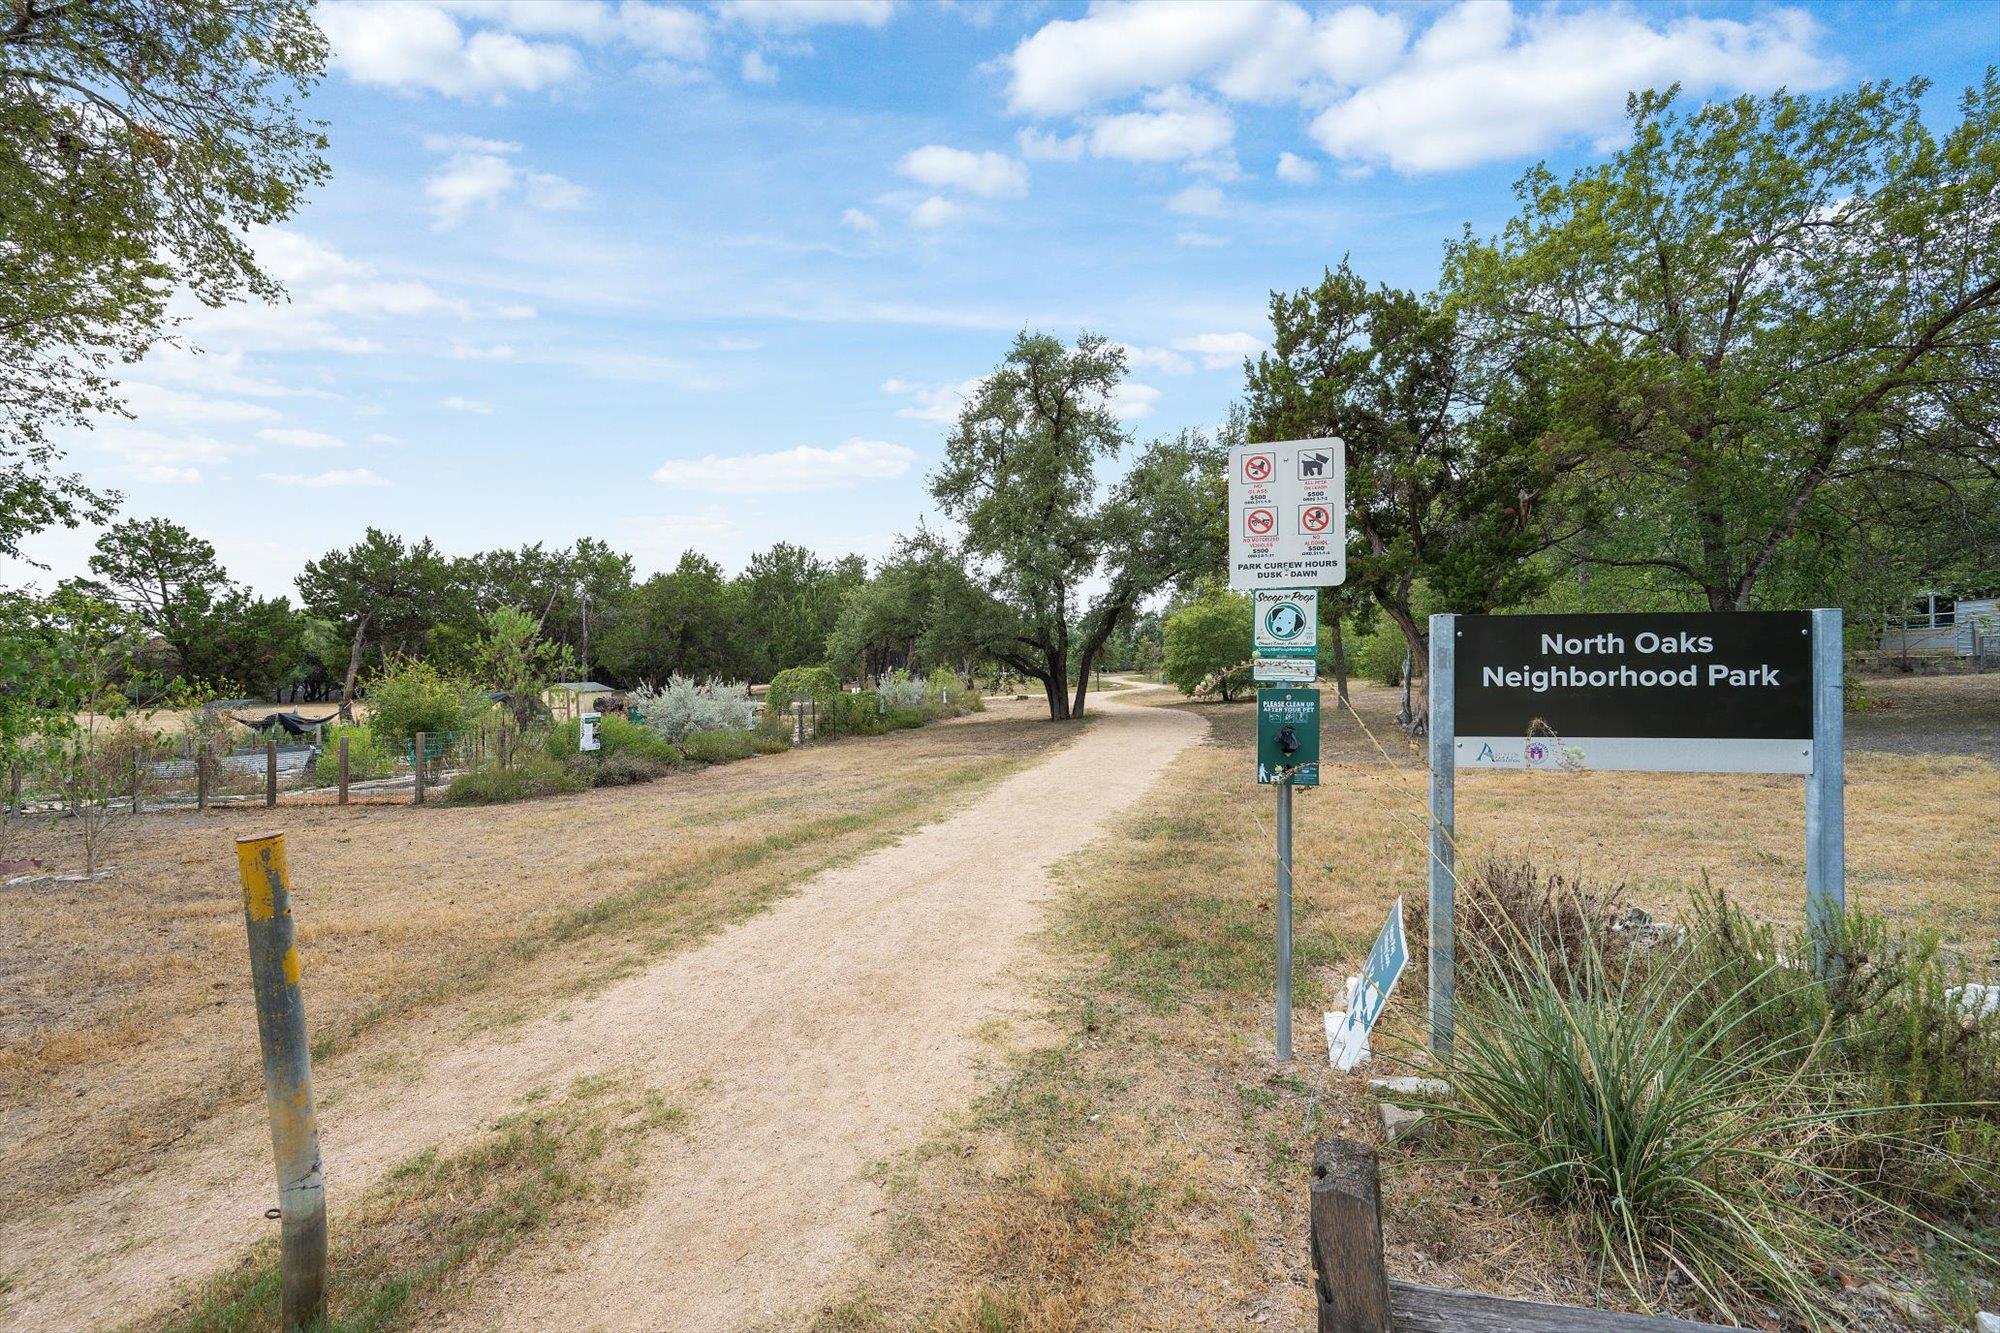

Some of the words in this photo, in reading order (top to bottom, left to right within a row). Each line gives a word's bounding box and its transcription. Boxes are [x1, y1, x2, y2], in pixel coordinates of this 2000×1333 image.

[1305, 560, 1338, 568] HOURS
[1257, 571, 1283, 579] DUSK
[1290, 570, 1318, 578] DAWN
[1256, 592, 1283, 603] Scoop
[1291, 591, 1316, 604] Poop
[1541, 632, 1625, 655] North
[1634, 632, 1714, 655] Oaks
[1483, 665, 1697, 693] Neighborhood
[1708, 664, 1780, 687] Park
